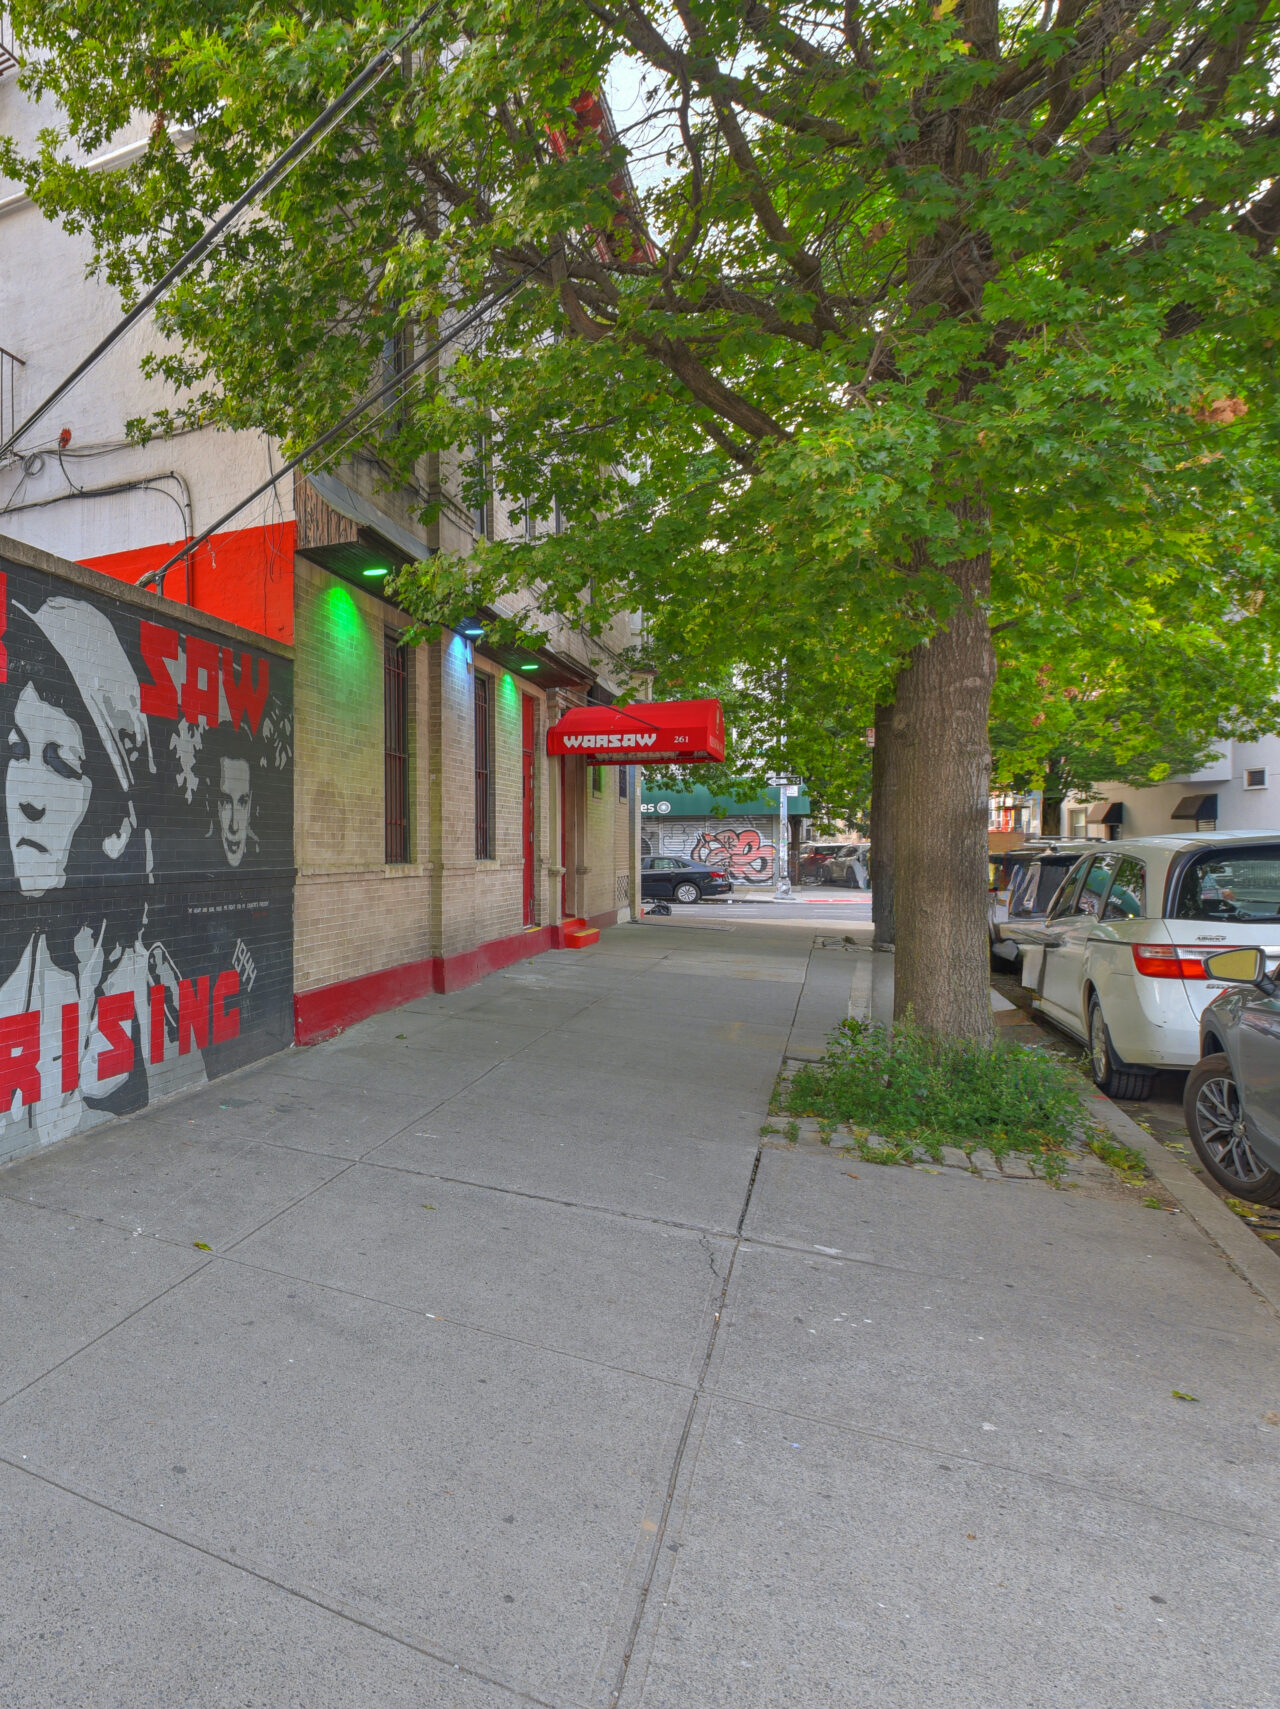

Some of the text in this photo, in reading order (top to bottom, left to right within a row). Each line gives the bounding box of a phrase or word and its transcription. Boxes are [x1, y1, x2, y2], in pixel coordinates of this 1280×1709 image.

[138, 620, 269, 737] SAW
[563, 733, 690, 748] WARSAW 261
[232, 938, 257, 993] 1944
